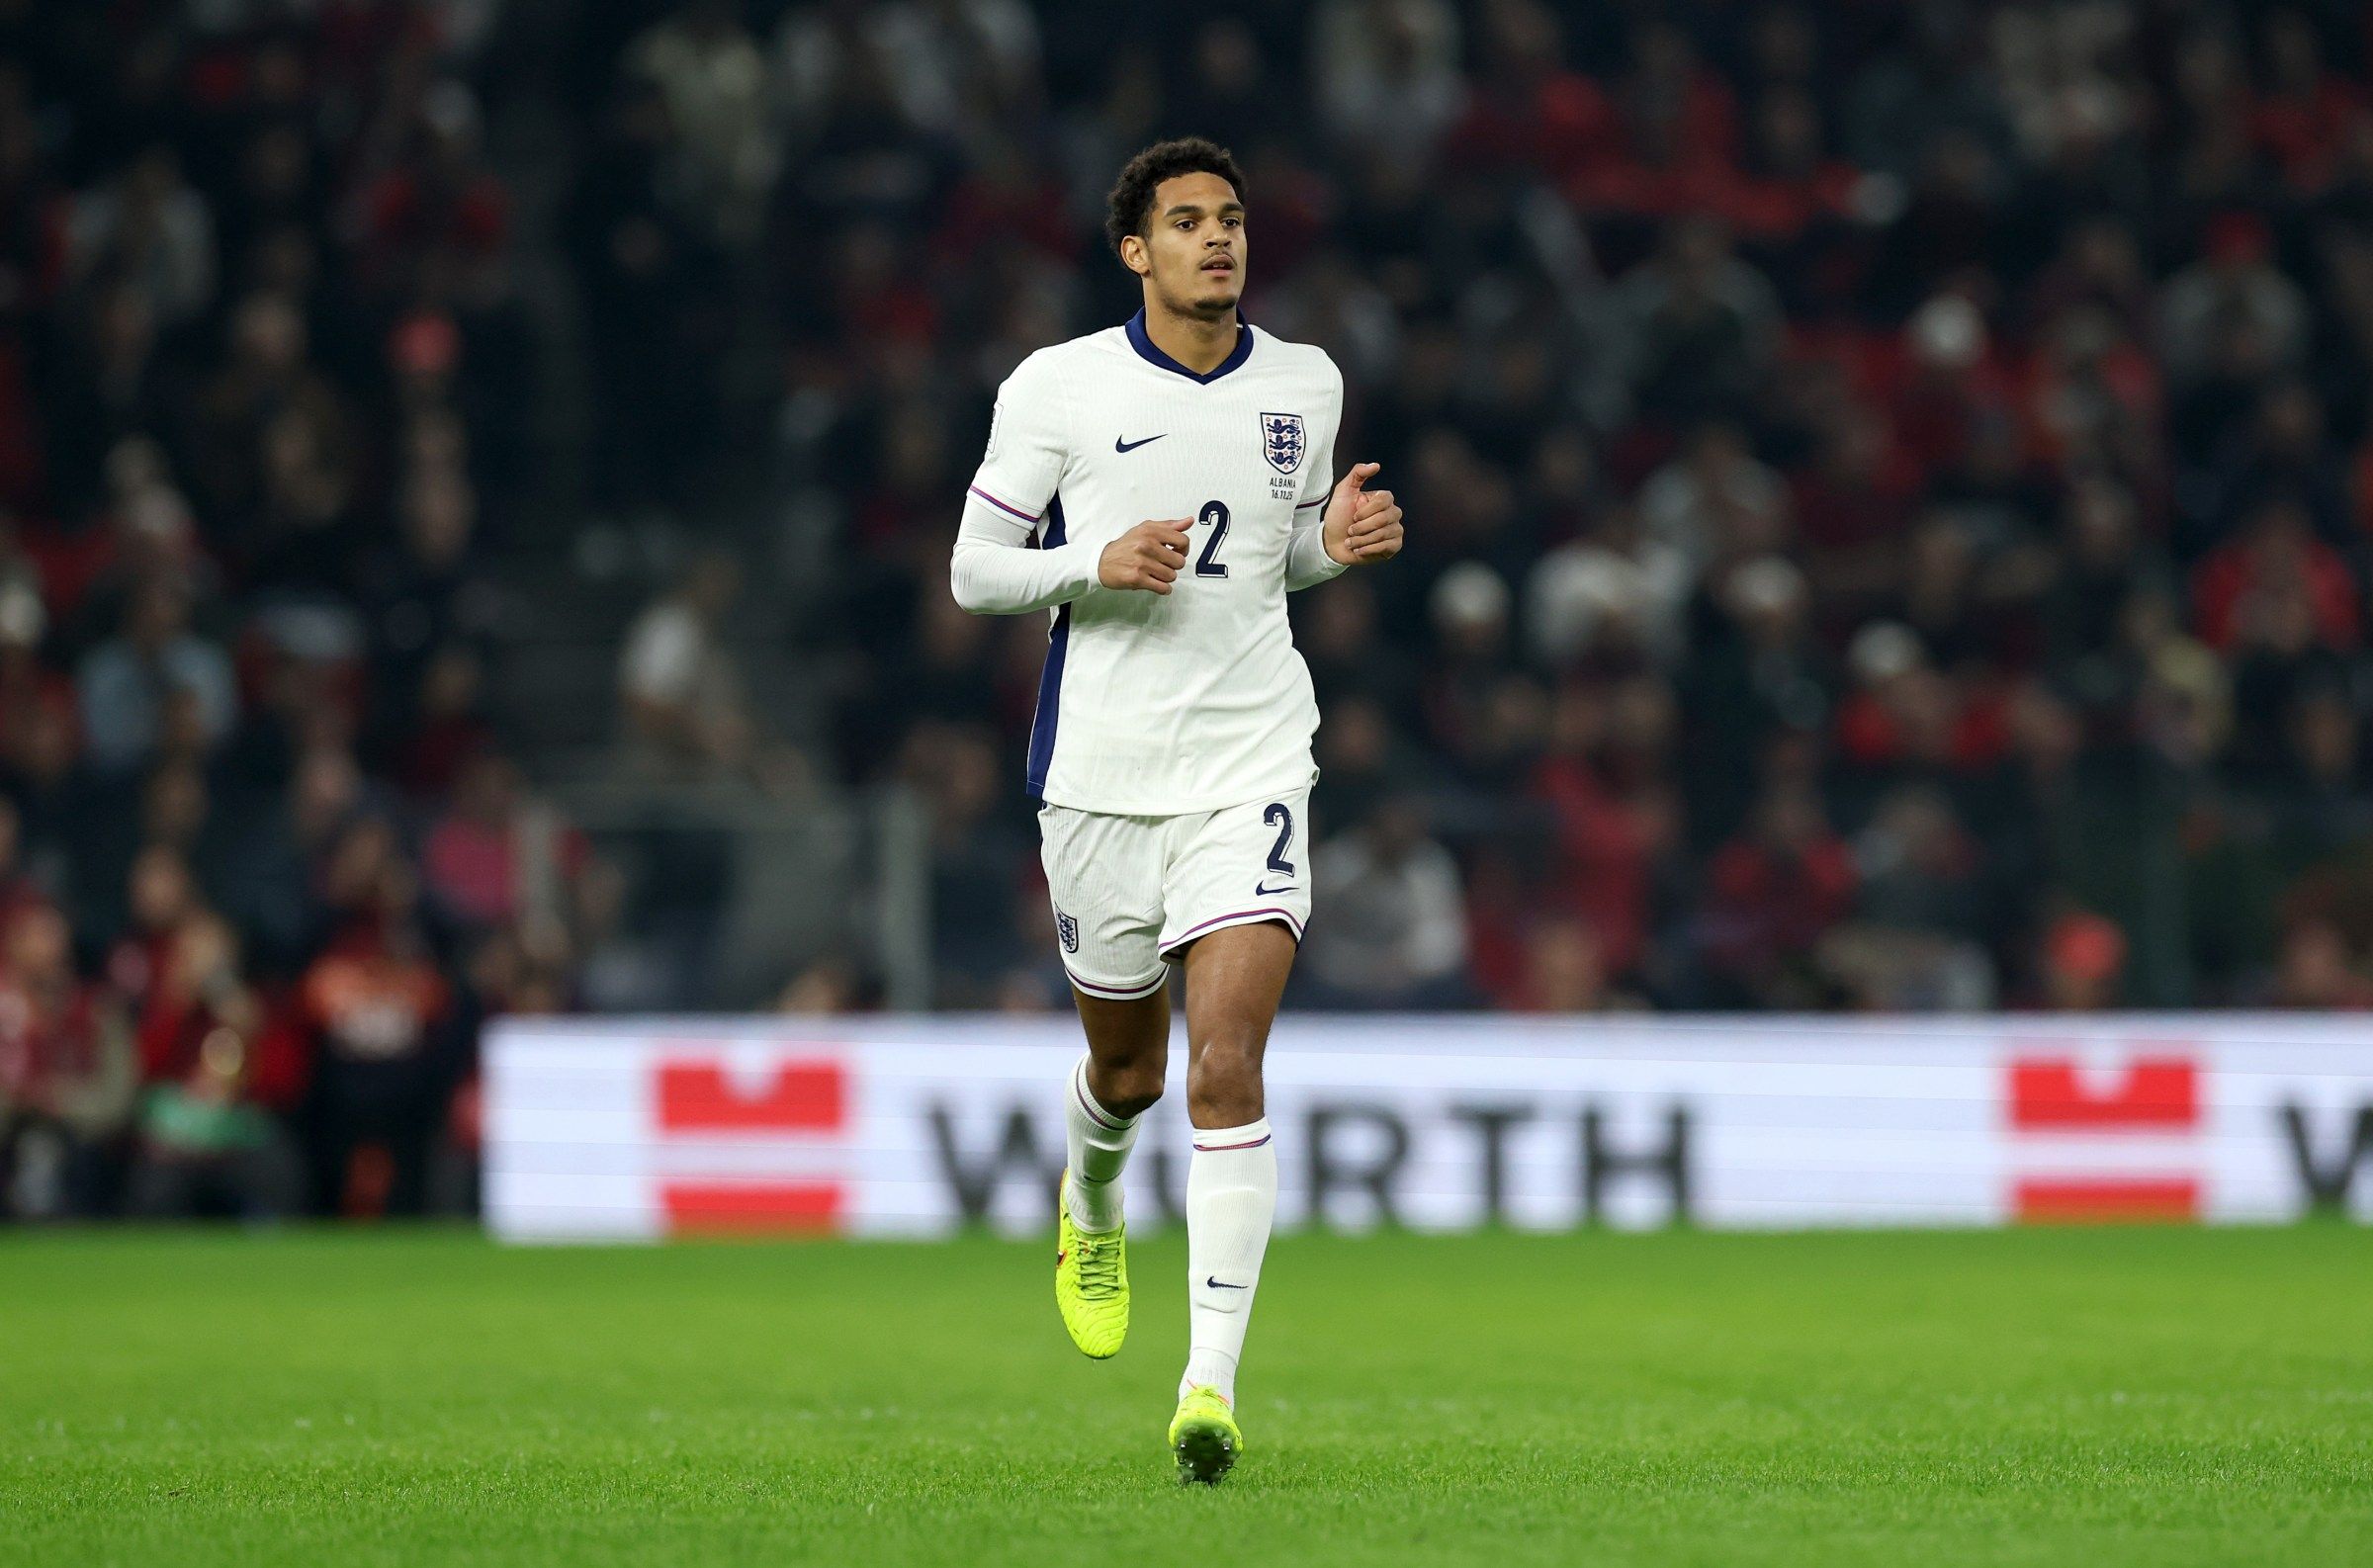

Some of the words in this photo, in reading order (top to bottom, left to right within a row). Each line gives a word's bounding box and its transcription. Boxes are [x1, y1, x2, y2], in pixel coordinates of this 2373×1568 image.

[1269, 477, 1296, 488] ALBANIA
[1195, 500, 1231, 578] 2
[1264, 803, 1295, 878] 2
